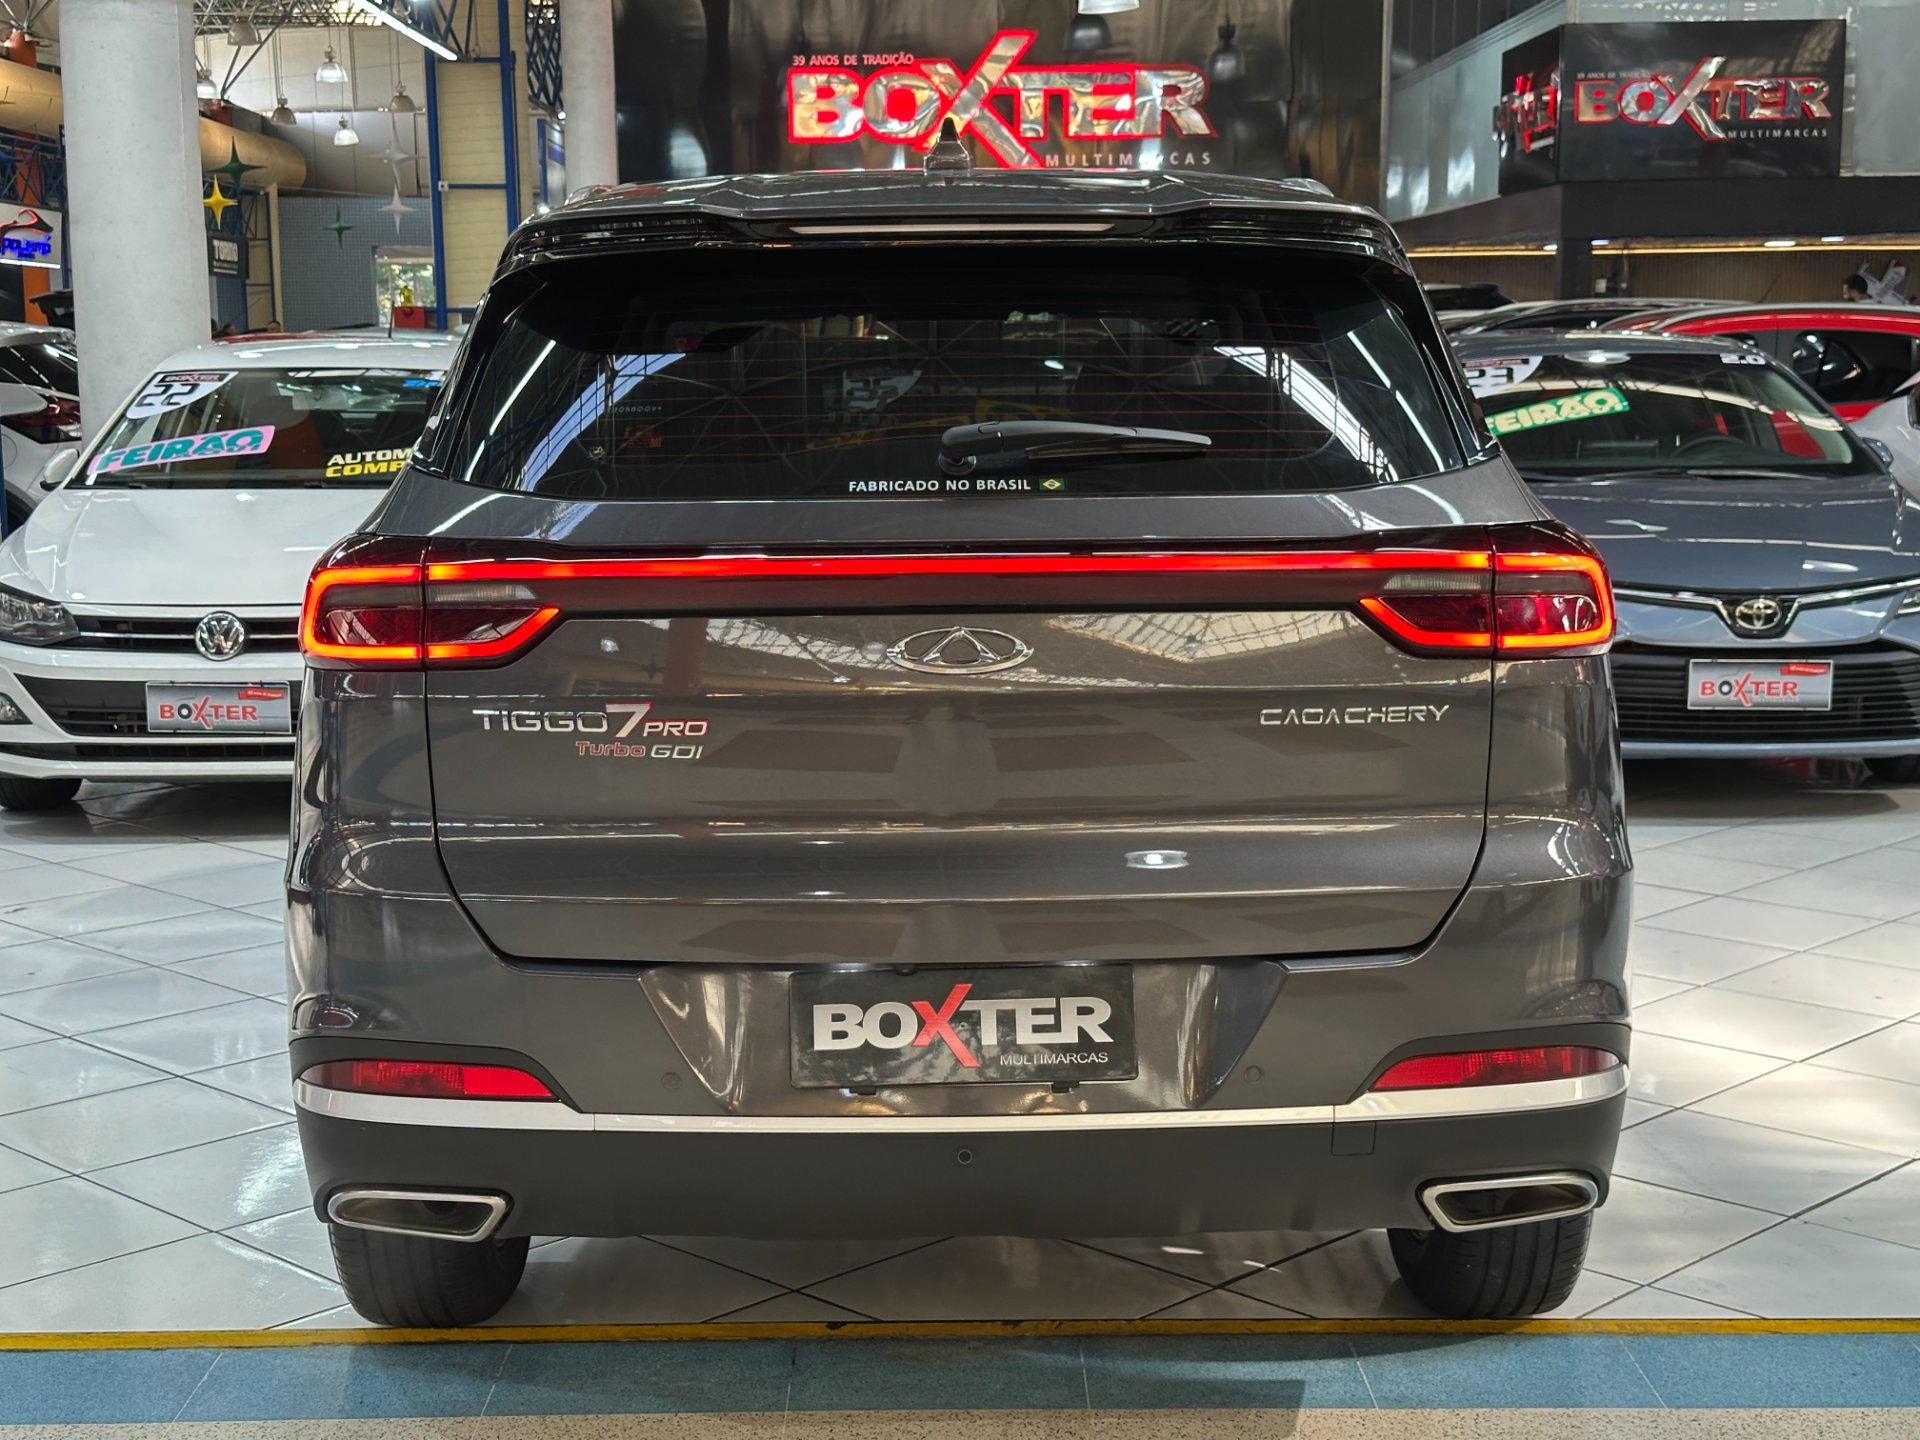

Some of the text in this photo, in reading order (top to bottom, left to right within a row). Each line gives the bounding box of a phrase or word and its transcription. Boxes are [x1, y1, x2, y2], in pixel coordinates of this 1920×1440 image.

[792, 51, 914, 66] 39 ANOS DE TRADIÇÃO
[788, 29, 1218, 168] BOXTER
[1574, 56, 1833, 141] BOXTER
[1728, 128, 1829, 139] MULTIMARCAS
[1045, 152, 1211, 167] MULTIMCAS
[164, 373, 220, 382] BOXTER
[135, 383, 200, 407] 22
[95, 427, 264, 471] FEIRÃO
[849, 479, 1031, 492] FABRICADO NO BRASIL
[1700, 672, 1799, 706] BOXTER
[159, 696, 258, 729] BOXTER
[576, 741, 704, 759] Turbo GDI
[812, 983, 1114, 1069] BOXTER
[1000, 1051, 1109, 1066] MULTIMARCAS
